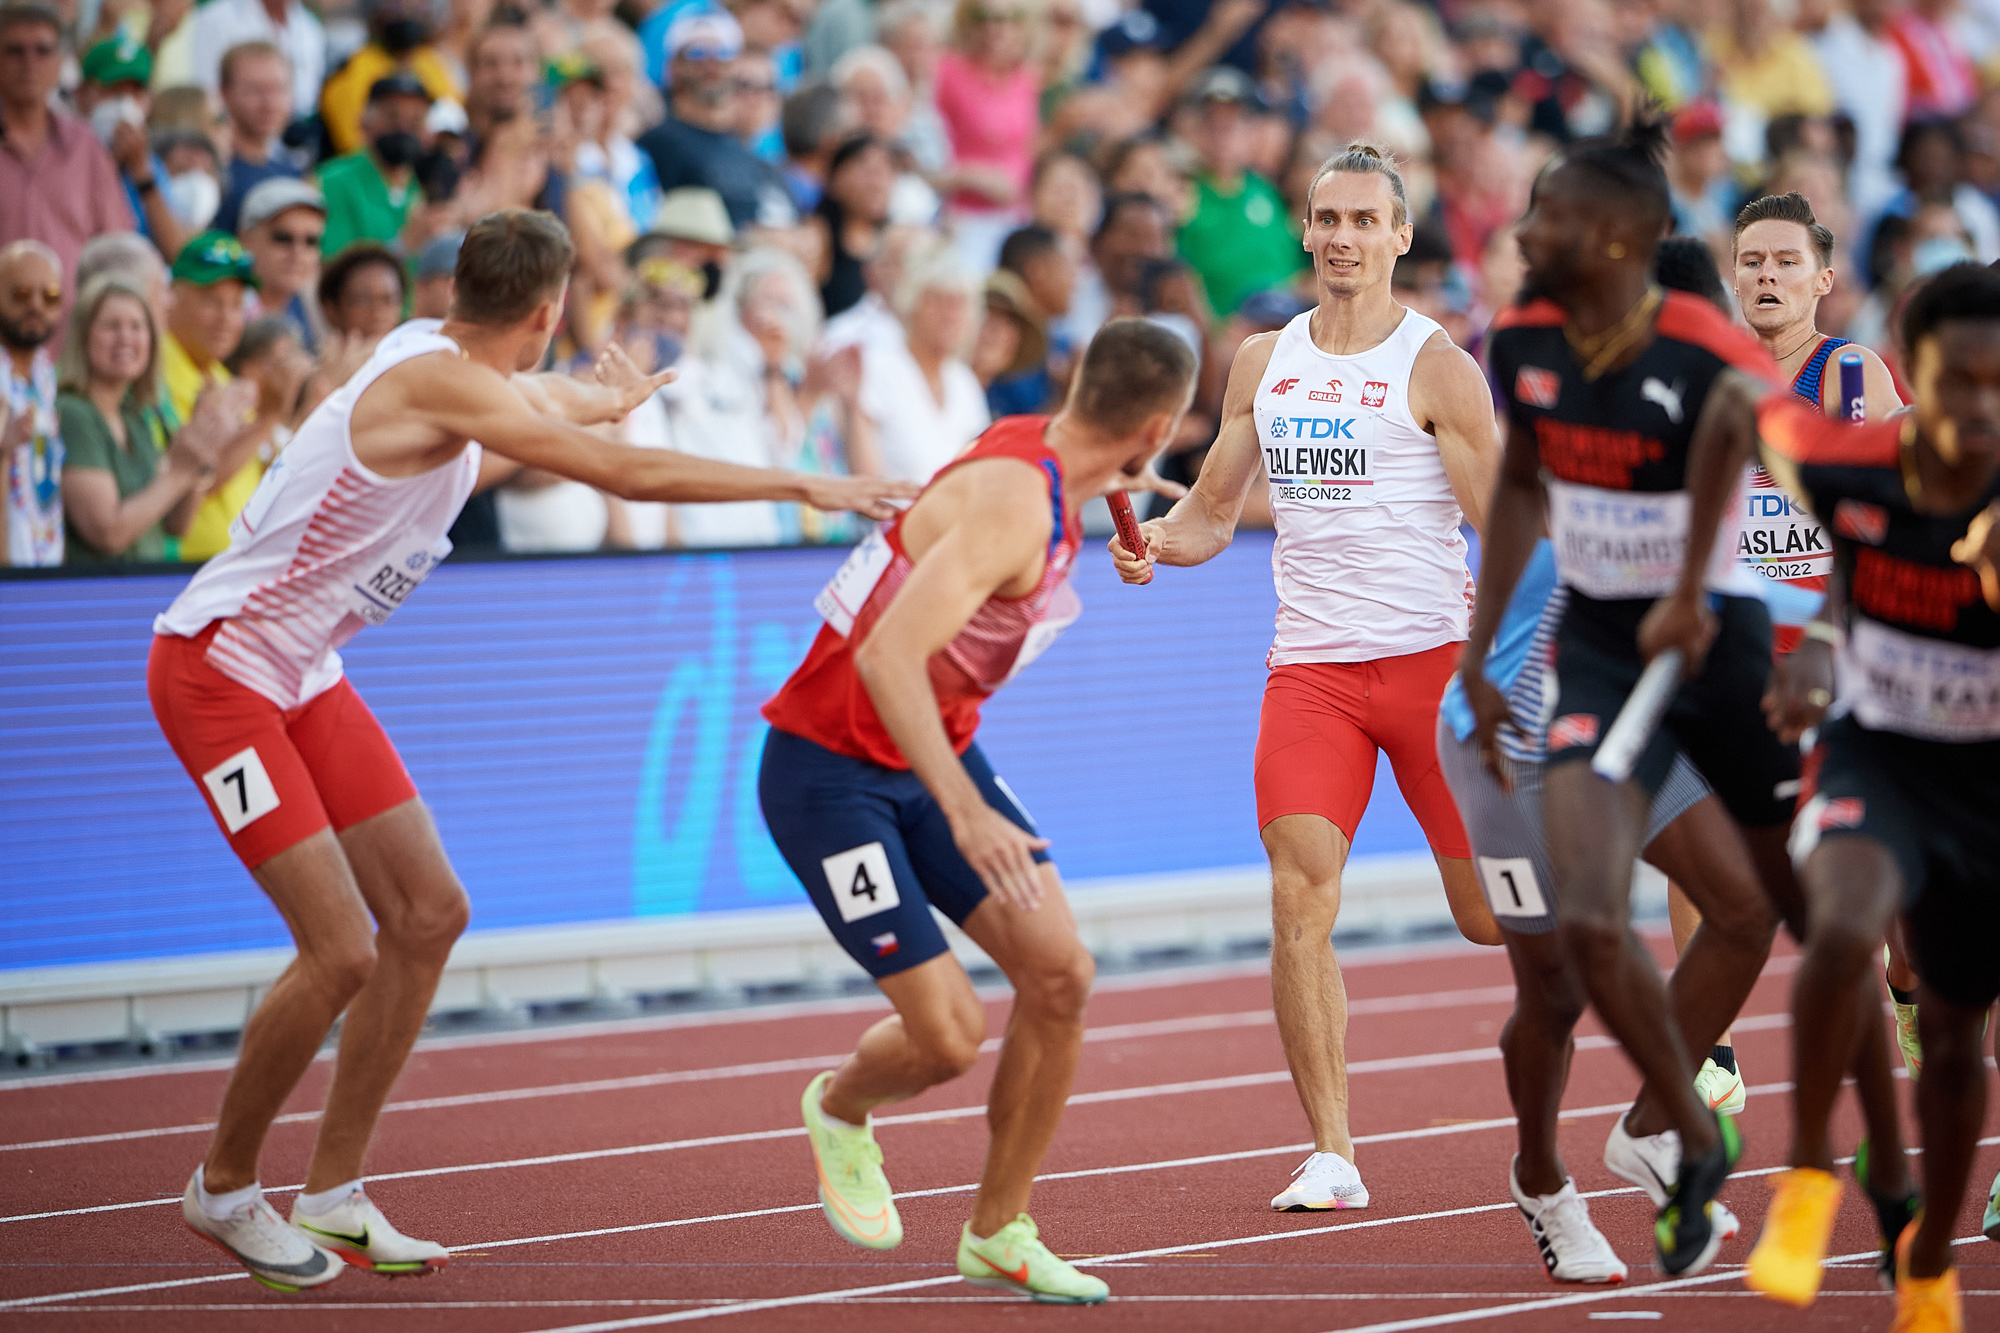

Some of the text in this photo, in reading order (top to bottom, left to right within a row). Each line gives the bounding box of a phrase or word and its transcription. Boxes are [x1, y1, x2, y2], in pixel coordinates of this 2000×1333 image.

[1270, 378, 1300, 395] 4F
[1310, 391, 1341, 403] ORLEN
[1289, 417, 1356, 439] TDK
[1265, 447, 1366, 476] ZALEWSKI
[1278, 486, 1352, 501] OREGON22
[1746, 494, 1808, 516] TDK
[1736, 523, 1825, 555] ASLÁK
[223, 767, 248, 814] 7
[852, 862, 877, 902] 4
[1501, 871, 1522, 907] 1
